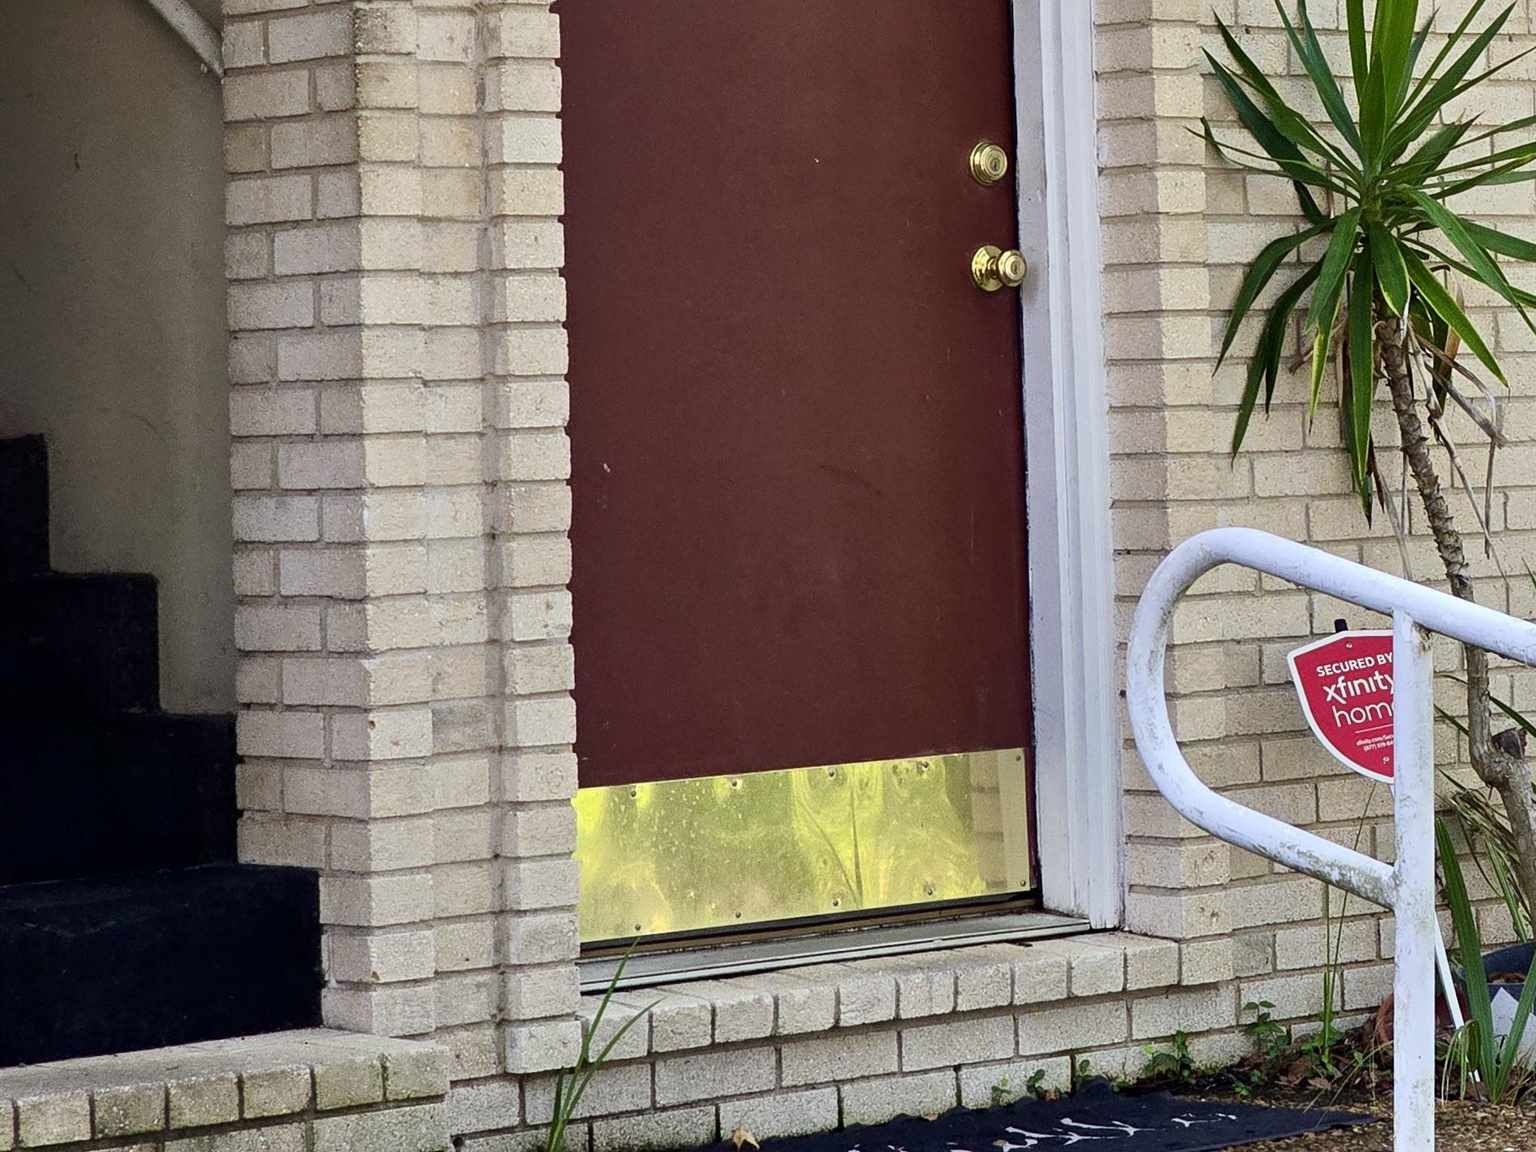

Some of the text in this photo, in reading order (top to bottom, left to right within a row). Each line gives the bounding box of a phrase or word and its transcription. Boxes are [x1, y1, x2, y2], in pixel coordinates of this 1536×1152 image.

[1316, 652, 1393, 677] SECURED BY
[1331, 701, 1393, 728] hom
